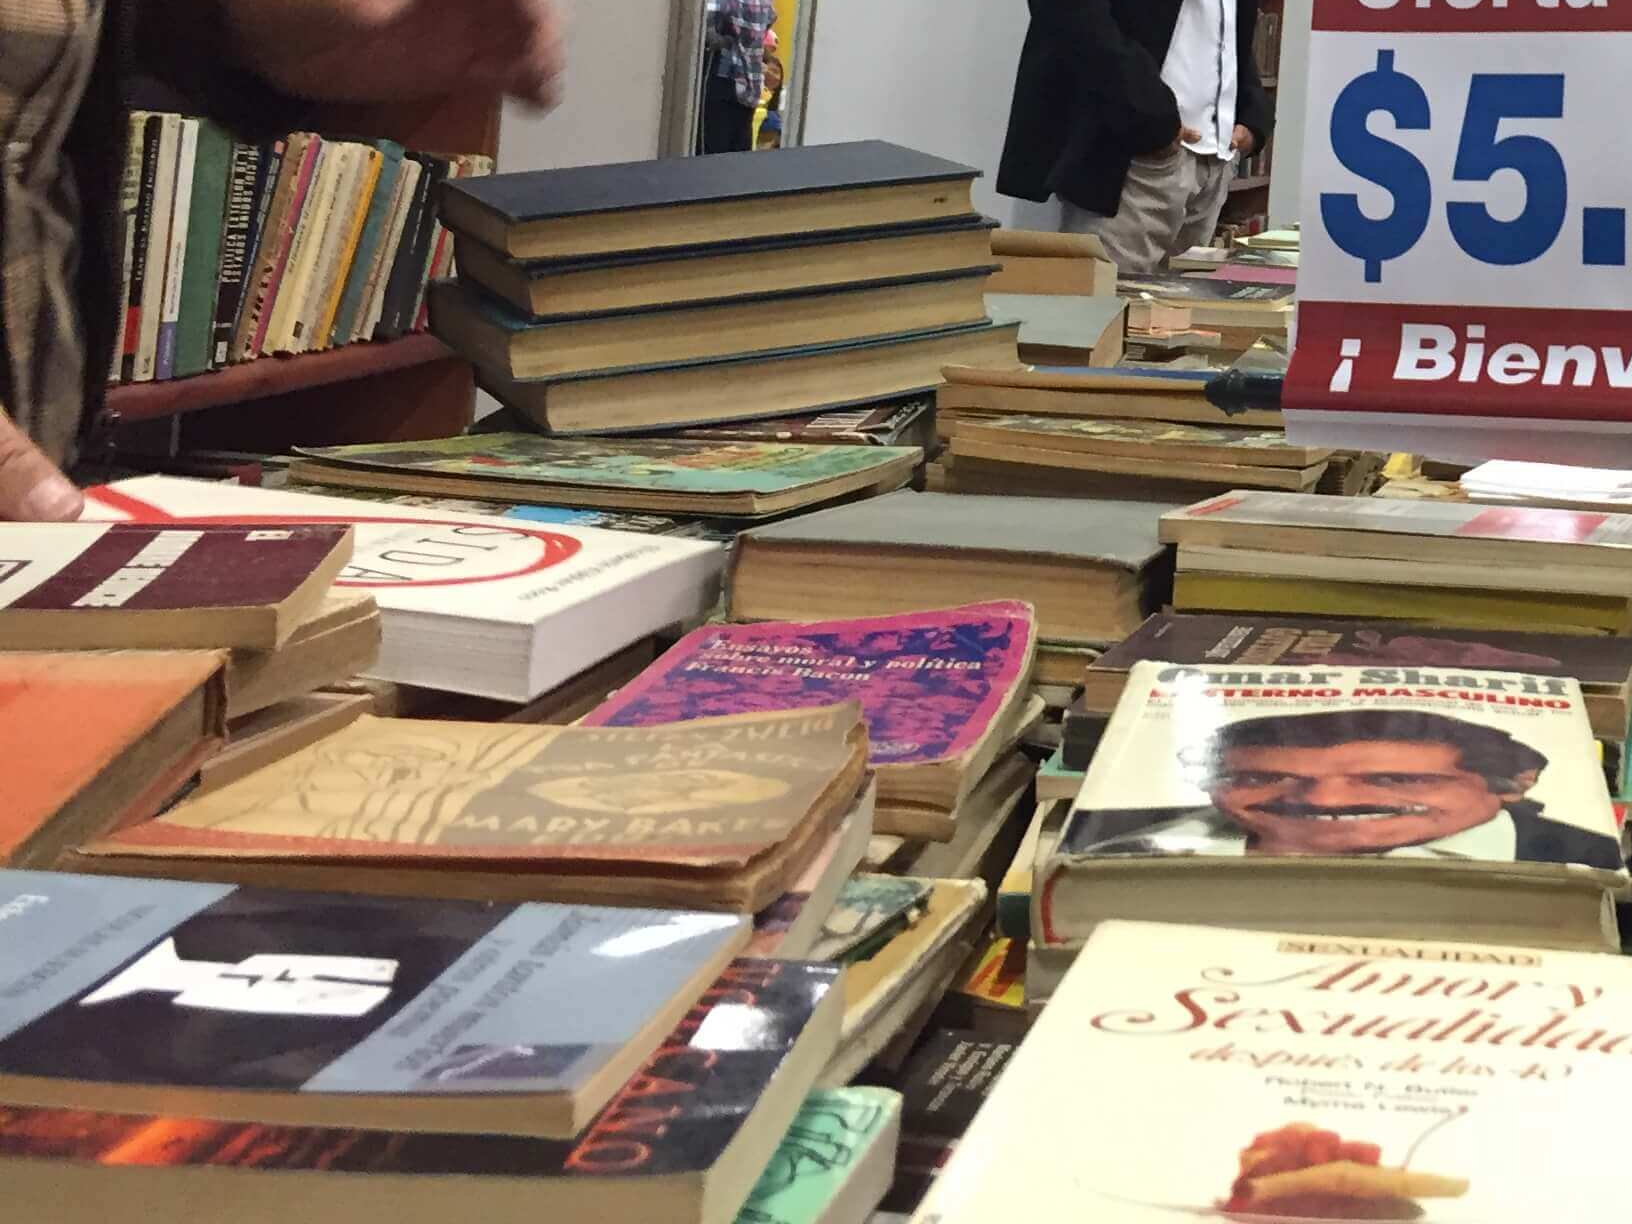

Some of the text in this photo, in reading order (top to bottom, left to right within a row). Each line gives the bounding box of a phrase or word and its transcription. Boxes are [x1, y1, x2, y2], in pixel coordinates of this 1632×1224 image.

[709, 638, 813, 656] Ensayos
[685, 661, 871, 682] Francis Bacon
[699, 650, 773, 664] sobre
[778, 655, 856, 669] moral
[861, 660, 877, 671] y
[1157, 667, 1569, 697] Omar Sharif
[1353, 687, 1572, 710] MASCULINO
[452, 814, 612, 834] MARY
[1285, 941, 1535, 966] SEXUALIDAD
[1200, 960, 1522, 1002] Amor
[1378, 1050, 1424, 1073] de
